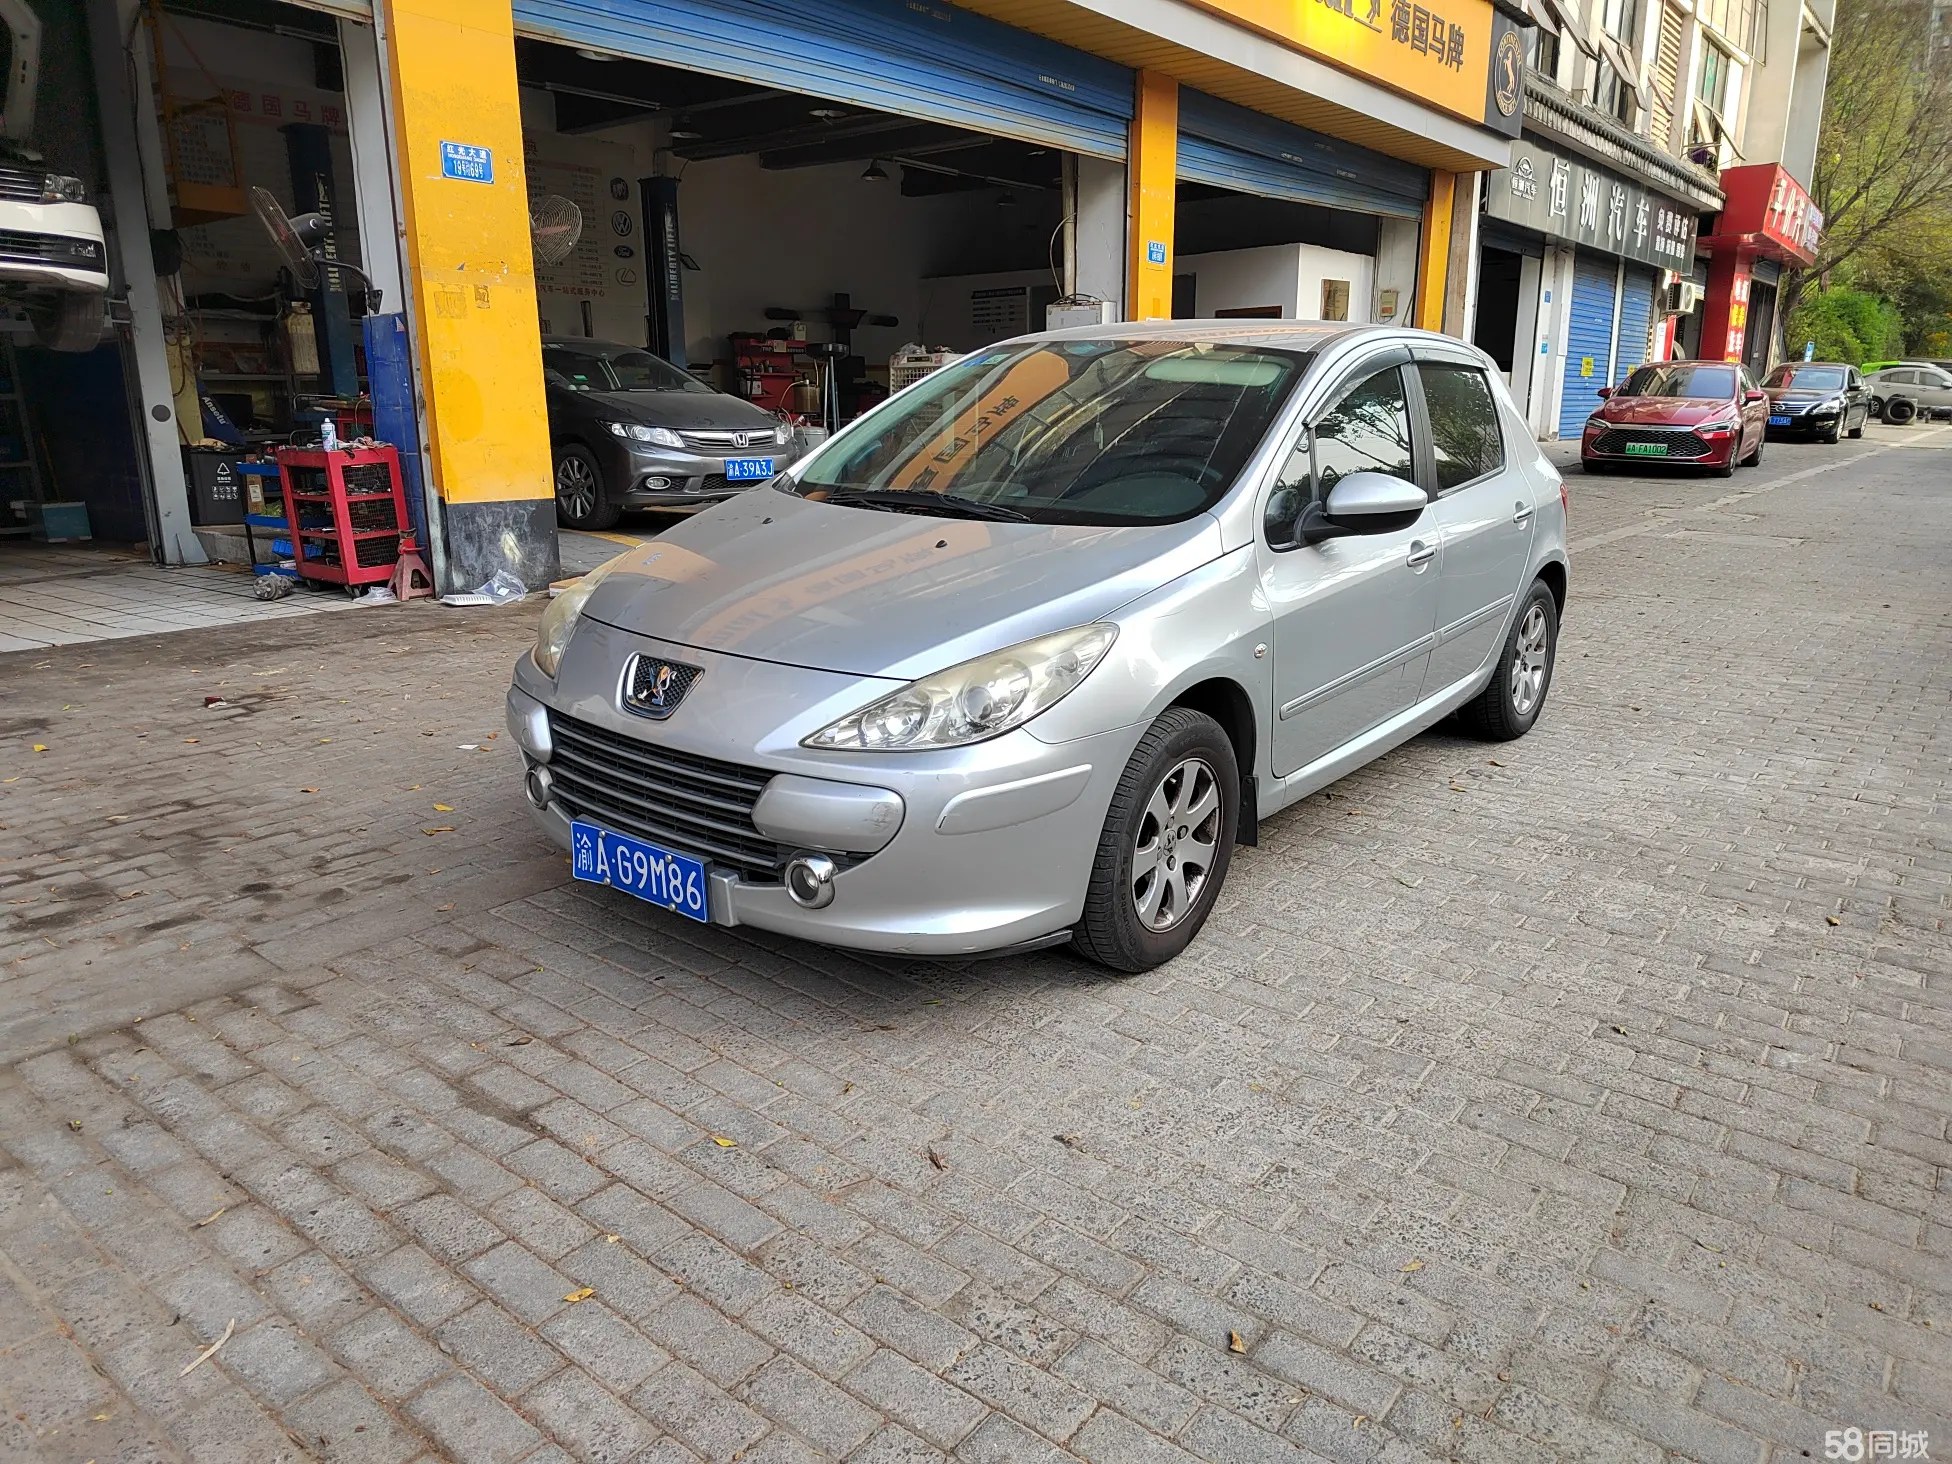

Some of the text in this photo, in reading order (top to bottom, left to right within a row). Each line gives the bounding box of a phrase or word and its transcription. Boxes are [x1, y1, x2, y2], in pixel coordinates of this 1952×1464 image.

[1391, 0, 1465, 72] 德国马牌
[1548, 157, 1650, 248] 恒洲汽车
